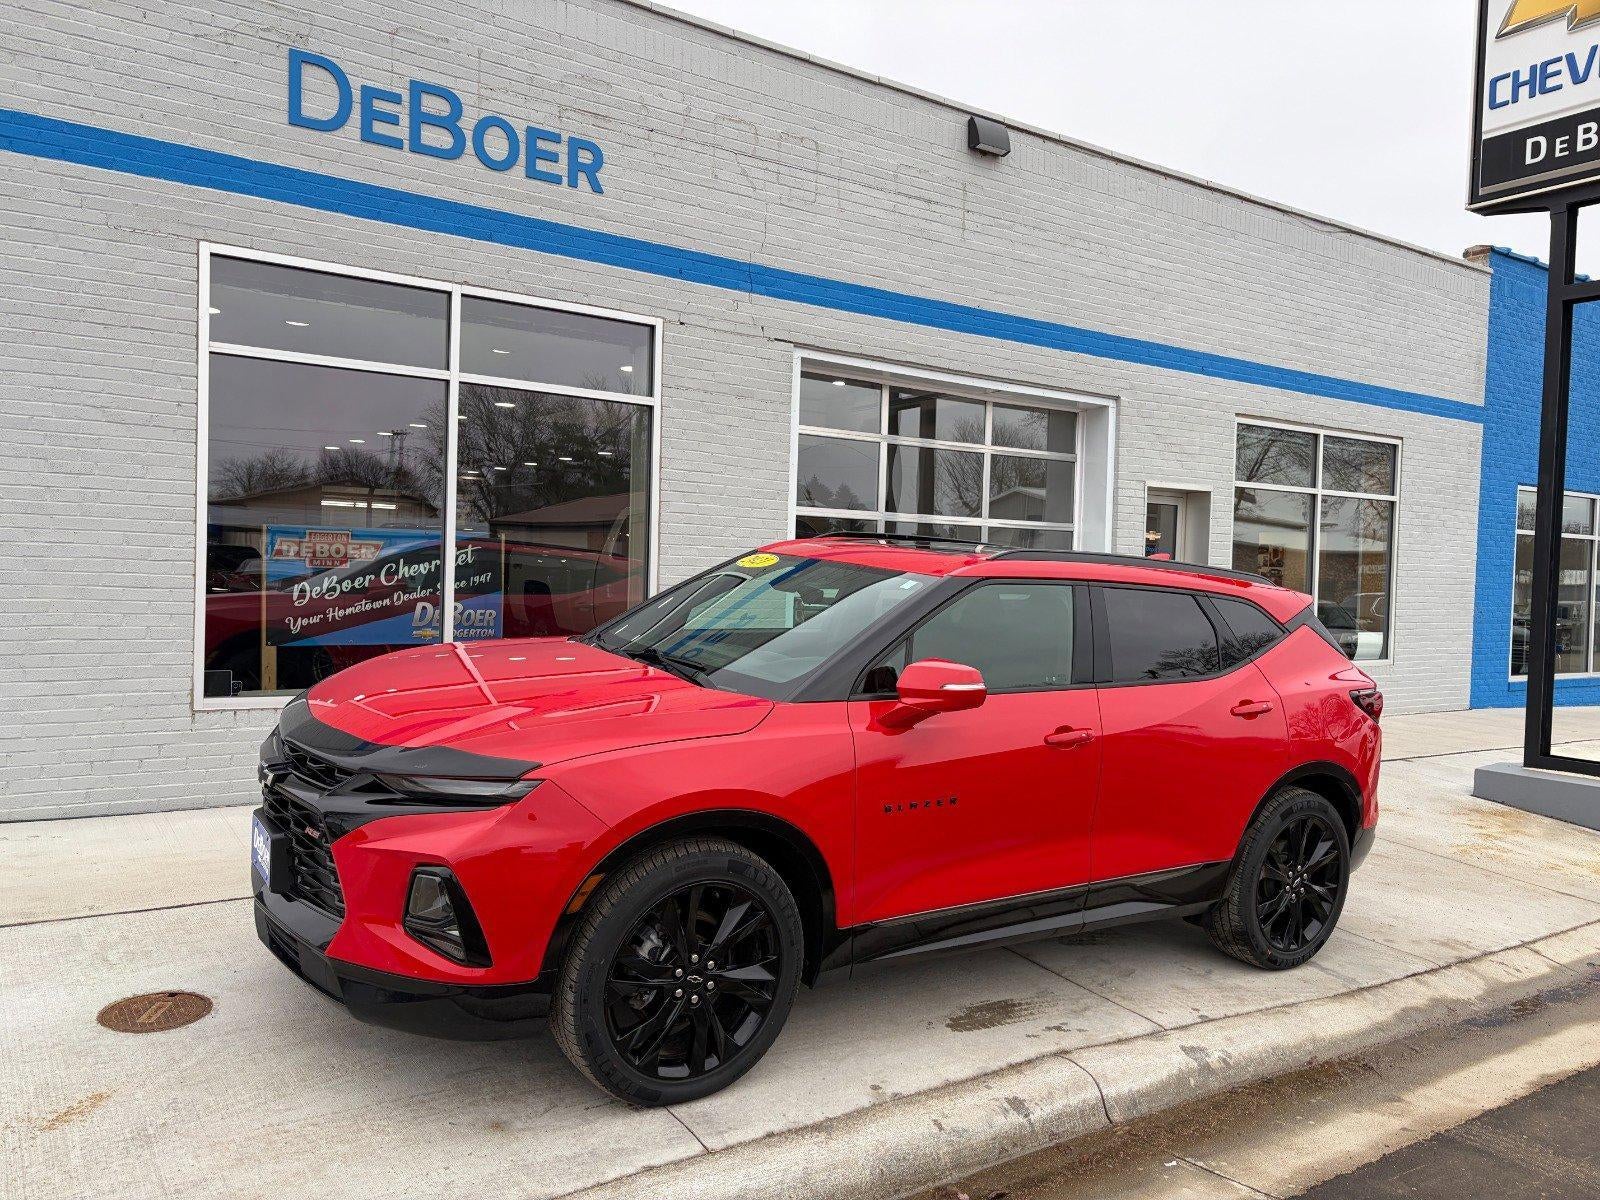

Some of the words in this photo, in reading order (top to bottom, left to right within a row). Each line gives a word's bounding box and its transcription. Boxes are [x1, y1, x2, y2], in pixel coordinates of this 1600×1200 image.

[1488, 44, 1600, 111] CHEV
[311, 532, 347, 541] EDGERTON
[292, 575, 376, 607] DeBoer
[380, 544, 482, 586] Chevret
[312, 559, 340, 567] MINN
[285, 614, 324, 635] Your
[326, 598, 391, 622] Hometown
[393, 586, 433, 606] Dealer
[469, 572, 492, 587] 1947
[884, 796, 958, 813] BLAZER
